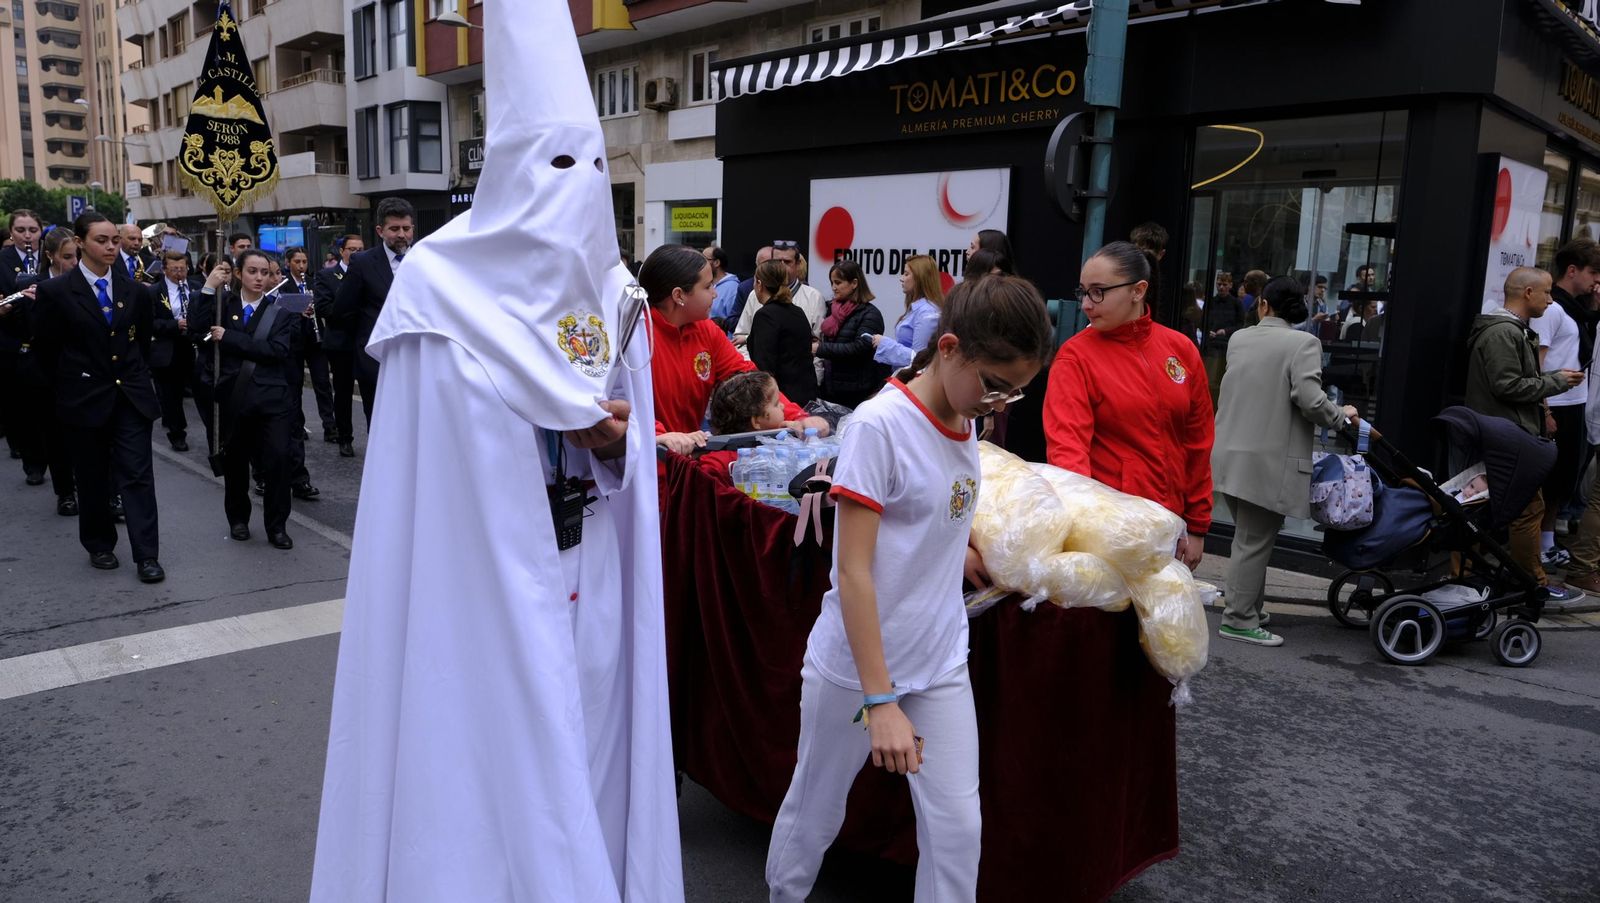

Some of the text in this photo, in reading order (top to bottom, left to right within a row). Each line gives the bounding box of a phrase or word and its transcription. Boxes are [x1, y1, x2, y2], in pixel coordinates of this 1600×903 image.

[207, 66, 260, 98] CASTILLO
[889, 63, 1077, 115] TOMATI&Co
[206, 119, 249, 136] SERÓN
[901, 109, 1061, 134] ALMERÍA PREMIUM CHERRY
[215, 132, 241, 145] 1988
[73, 198, 81, 213] P
[679, 220, 704, 229] COLCHAS
[889, 248, 917, 276] DE
